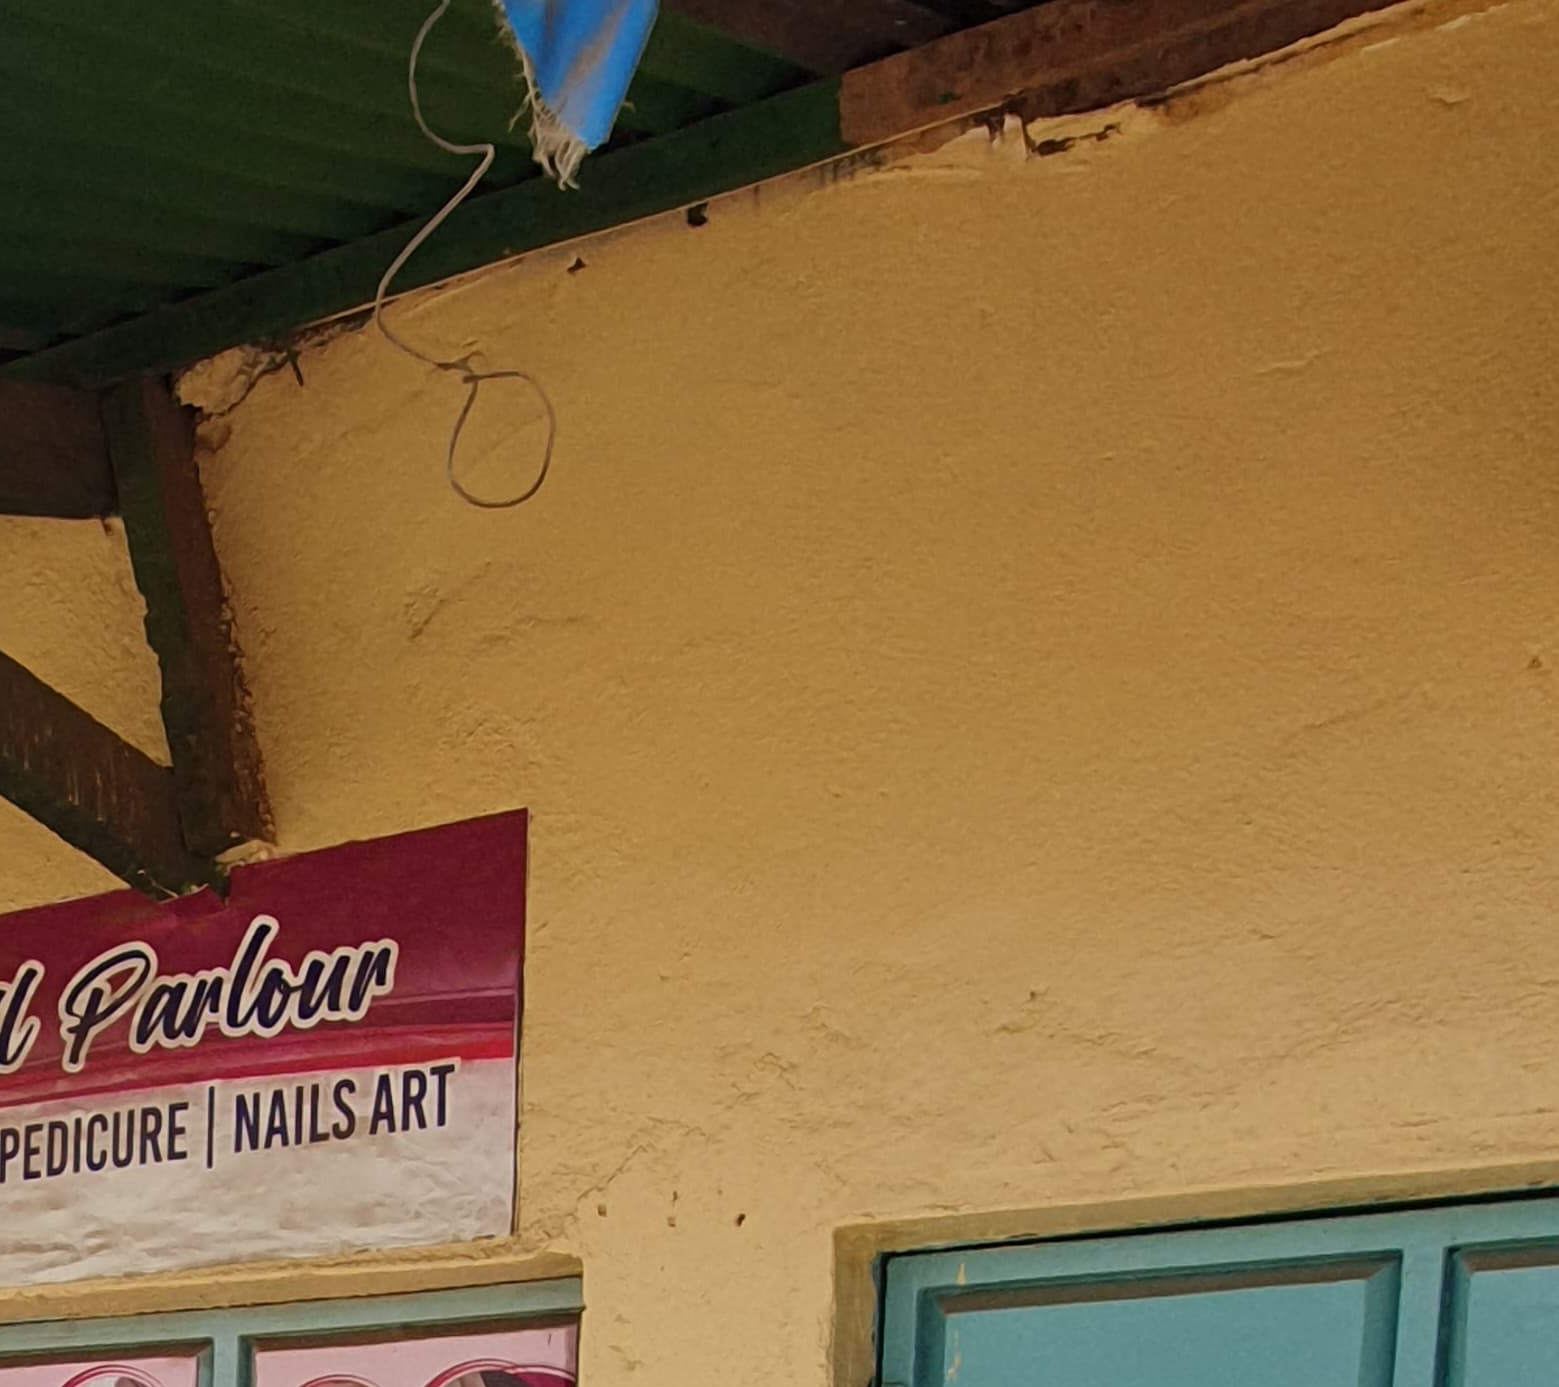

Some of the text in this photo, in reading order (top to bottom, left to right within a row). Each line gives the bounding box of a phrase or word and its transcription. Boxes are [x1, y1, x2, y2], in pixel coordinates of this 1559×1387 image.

[60, 914, 398, 1072] Parlour
[233, 1078, 357, 1154] NAILS
[368, 1063, 456, 1136] ART
